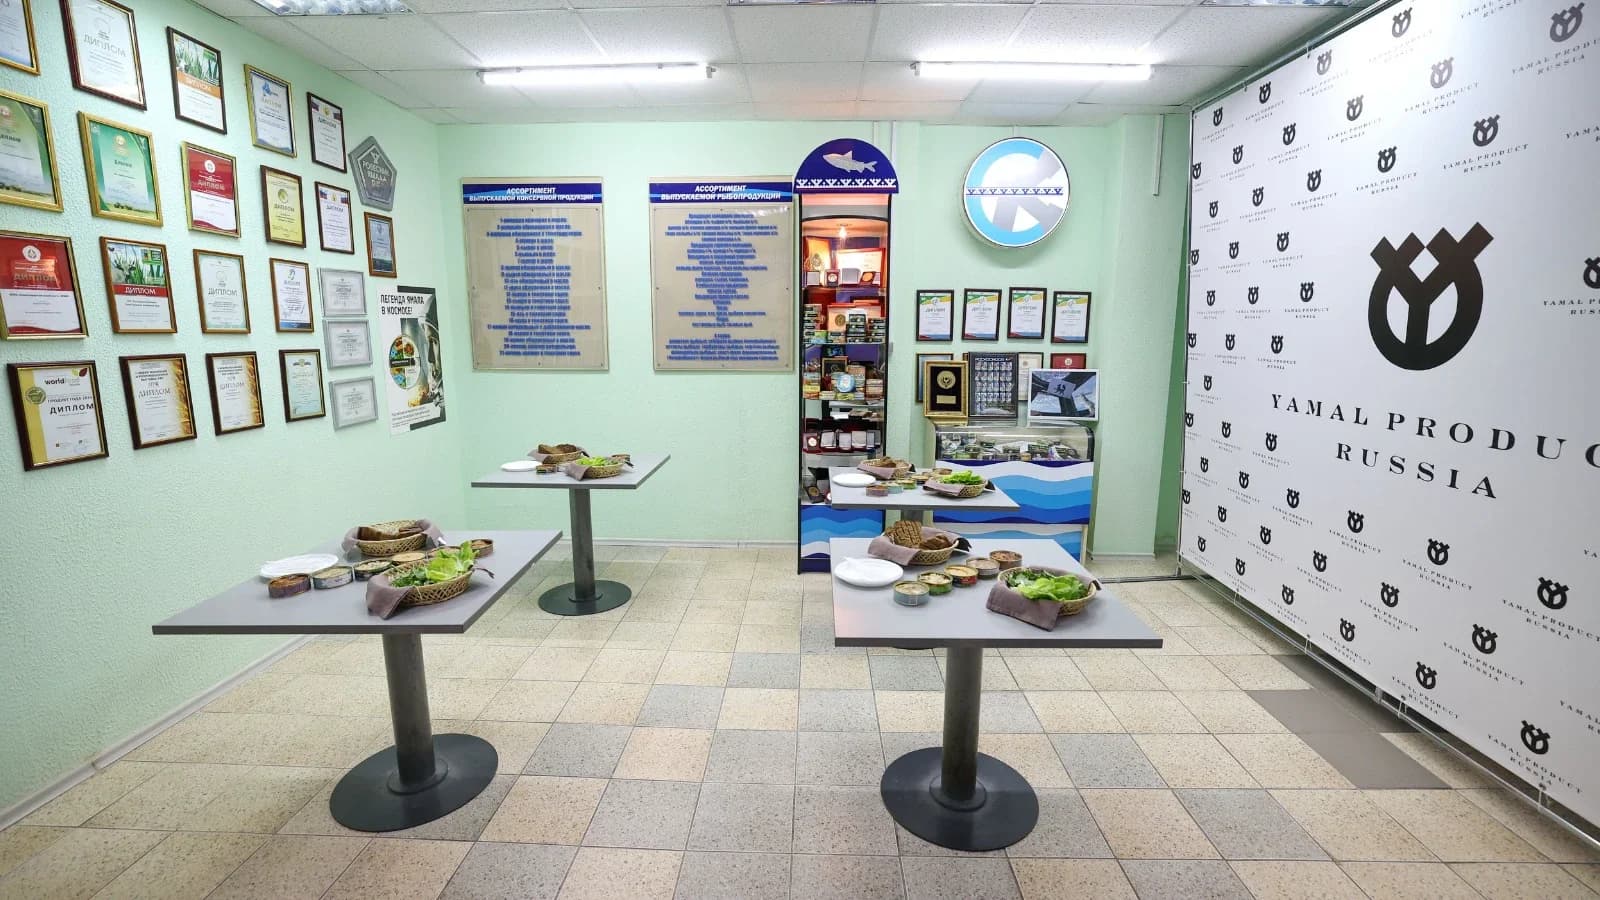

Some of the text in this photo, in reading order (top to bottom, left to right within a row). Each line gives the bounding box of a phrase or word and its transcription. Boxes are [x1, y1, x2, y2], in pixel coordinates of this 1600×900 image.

[83, 34, 127, 57] ДИПЛОМ
[1538, 54, 1585, 75] RUSSIA
[1443, 143, 1529, 170] YAMAL PRODUCT
[1464, 160, 1502, 173] RUSSIA
[506, 187, 556, 195] АССОРТИМЕНТ
[661, 192, 781, 201] ВЫПУСКАЕМОЙ РЫБОПРОДУКЦИИ
[125, 286, 156, 295] ДИПЛОМ
[208, 287, 238, 297] ДИПЛОМ
[380, 294, 425, 305] ЛЕГЕНДА ЯМАЛА
[381, 306, 413, 315] В КОСМОСЕ!
[1543, 298, 1584, 306] YAMAL
[49, 402, 94, 415] ДИПЛОМ
[1271, 393, 1369, 426] YAMAL
[1335, 442, 1497, 499] RUSSIA
[1402, 559, 1473, 591] YAMAL PRODUCT
[1419, 573, 1451, 590] RUSSIA
[1502, 599, 1600, 642] YAMAL PRODUCT
[1526, 617, 1570, 640] RUSSIA
[1443, 641, 1525, 686] YAMAL PRODUCT
[1462, 660, 1499, 682] RUSSIA
[1488, 733, 1583, 794] YAMAL PRODUCT
[1510, 756, 1552, 785] RUSSIA
